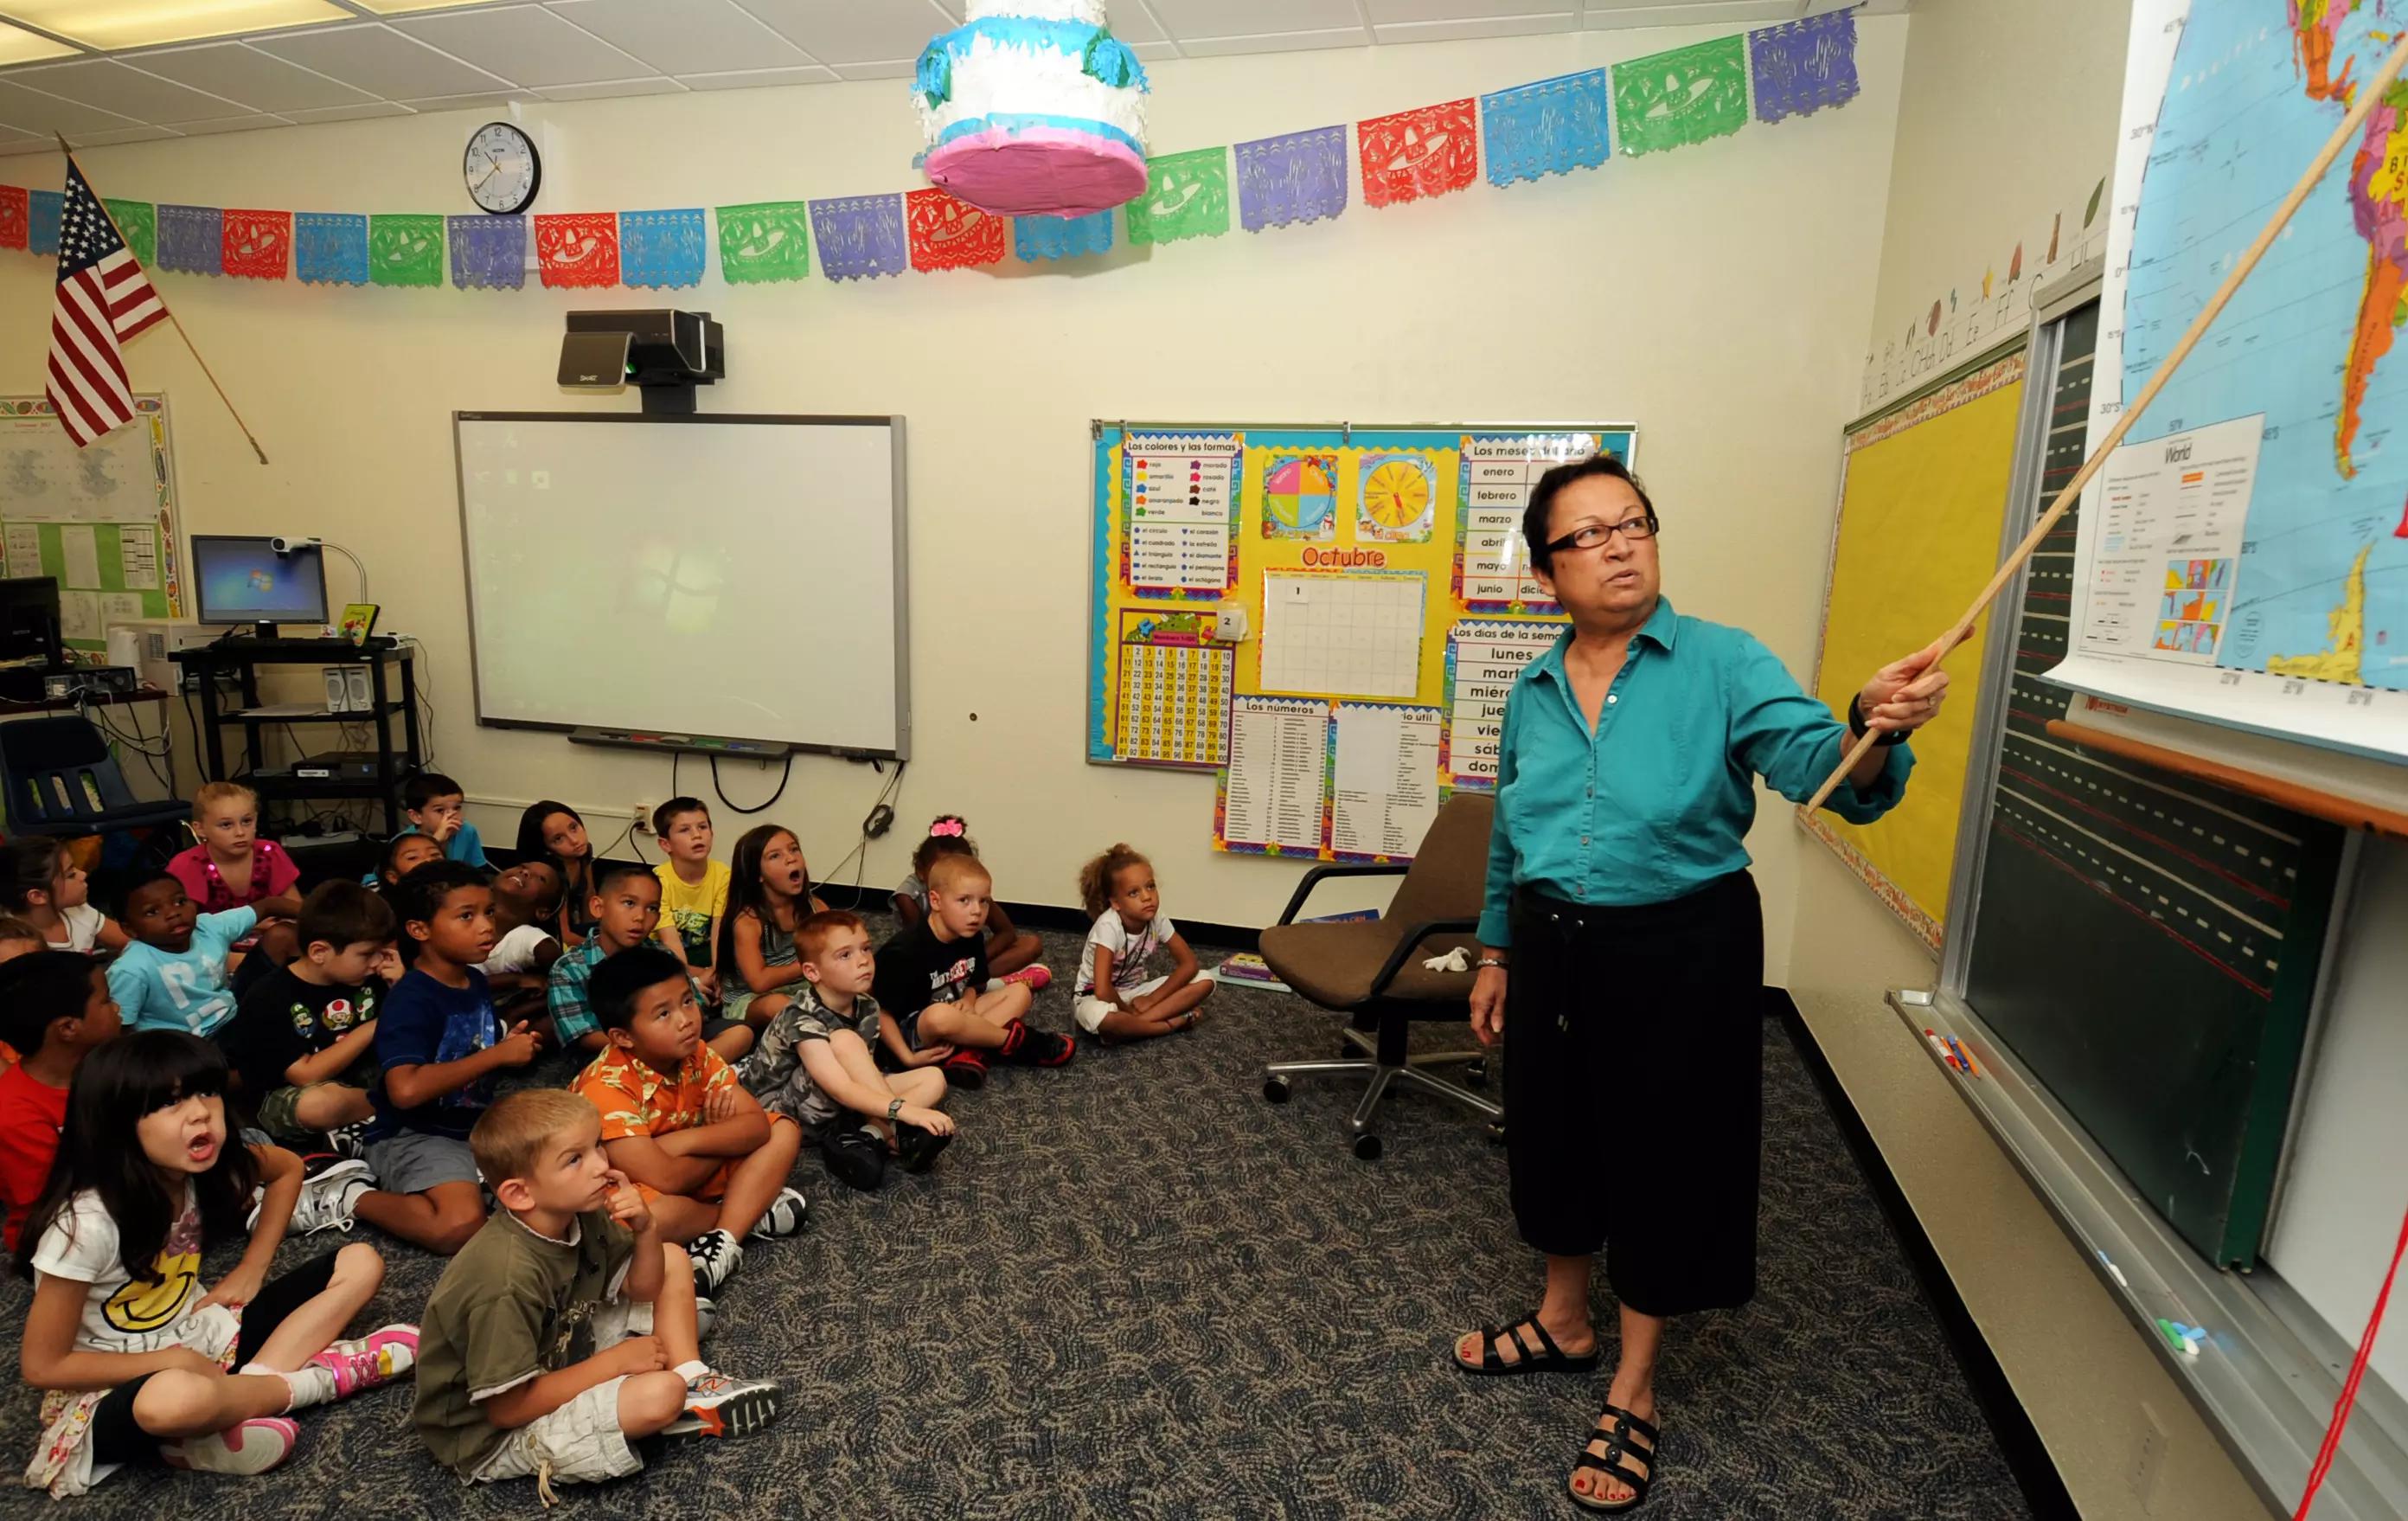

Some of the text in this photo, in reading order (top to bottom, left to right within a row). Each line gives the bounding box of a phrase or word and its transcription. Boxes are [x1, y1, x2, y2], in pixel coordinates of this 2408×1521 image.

[495, 127, 502, 137] 12
[471, 147, 477, 156] 10
[1204, 443, 1236, 452] formas
[1474, 446, 1492, 455] Los
[2165, 443, 2193, 464] World
[1477, 491, 1516, 500] febrero
[1303, 547, 1386, 567] Octubre
[1476, 562, 1506, 574] mayo
[1296, 587, 1300, 595] 1
[1477, 583, 1503, 594] junio
[1521, 585, 1545, 594] dicie
[1501, 630, 1515, 639] de
[1518, 631, 1527, 639] la
[1491, 648, 1533, 660] lunes
[1483, 668, 1520, 679] mart
[1246, 703, 1265, 711] Los
[1481, 704, 1505, 717] jue
